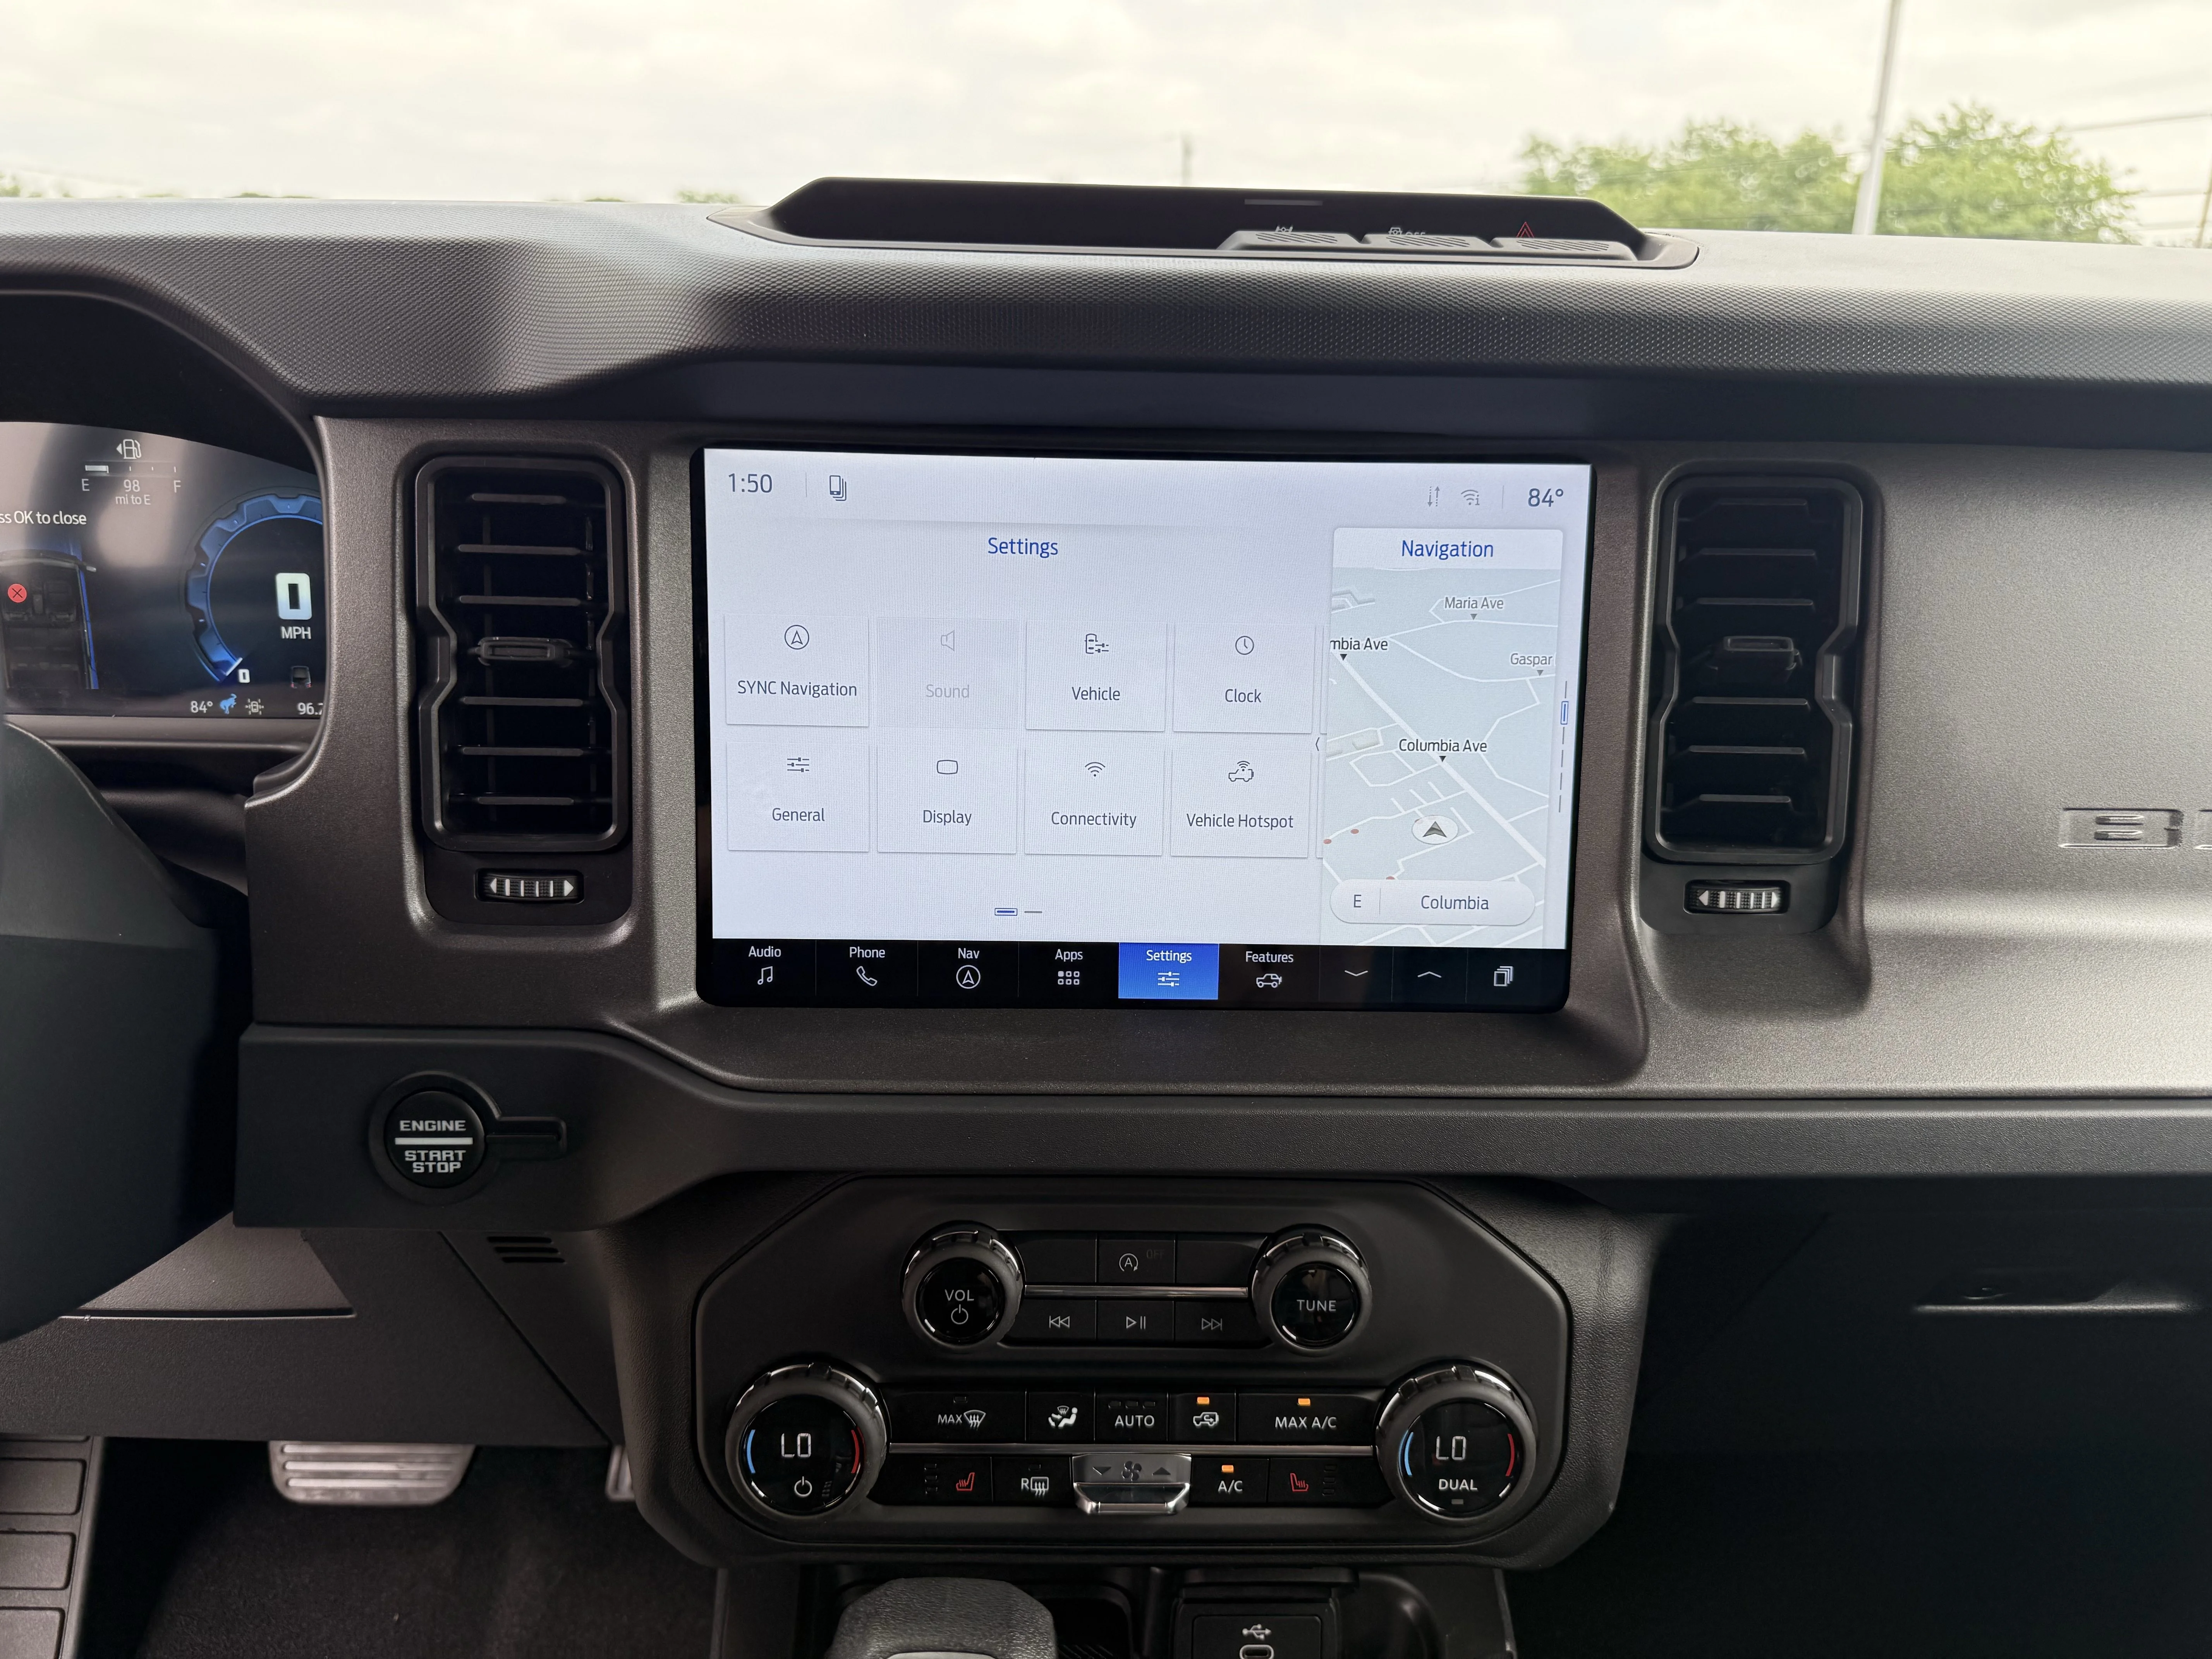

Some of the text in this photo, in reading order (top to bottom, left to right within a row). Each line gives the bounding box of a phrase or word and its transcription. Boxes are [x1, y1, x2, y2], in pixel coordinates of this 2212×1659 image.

[82, 479, 89, 491] E
[124, 480, 140, 492] 98
[174, 480, 180, 493] F
[729, 474, 772, 493] 1:50
[116, 494, 151, 505] mi to E
[1528, 488, 1563, 507] 84°
[14, 511, 33, 524] OK
[36, 512, 50, 524] to
[53, 511, 86, 524] close
[988, 538, 1058, 558] Settings
[1402, 540, 1493, 560] Navigation
[276, 573, 312, 620] 0
[1445, 597, 1503, 609] Maria Ave
[281, 627, 311, 639] MPH
[1364, 638, 1388, 650] Ave
[1511, 653, 1553, 666] Gaspar
[239, 669, 250, 683] 0
[738, 680, 856, 698] SYNC Navigation
[926, 684, 969, 698] Sound
[1072, 687, 1120, 700] Vehicle
[1225, 689, 1261, 702] Clock
[191, 701, 213, 713] 84°
[1400, 739, 1487, 752] Columbia Ave
[773, 808, 824, 821] General
[924, 810, 972, 826] Display
[1052, 812, 1136, 828] Connectivity
[1187, 814, 1293, 830] Vehicle Hotspot
[1354, 895, 1361, 907] E
[1422, 895, 1489, 909] Columbia
[749, 946, 781, 957] Audio
[850, 946, 885, 958] Phone
[958, 948, 979, 958] Nav
[1055, 949, 1083, 962] Apps
[1147, 950, 1192, 963] Settings
[1246, 951, 1293, 962] Features
[400, 1121, 465, 1131] ENGINE
[405, 1151, 465, 1161] START
[413, 1162, 460, 1172] STOP
[945, 1290, 974, 1301] VOL
[1297, 1300, 1336, 1311] TUNE
[938, 1415, 962, 1423] MAX
[1115, 1415, 1154, 1426] AUTO
[1275, 1417, 1336, 1429] MAX A/C
[781, 1433, 811, 1457] LO
[1436, 1436, 1466, 1460] LO
[1021, 1478, 1029, 1489] R
[1218, 1480, 1242, 1492] A/C
[1439, 1479, 1477, 1490] DUAL
